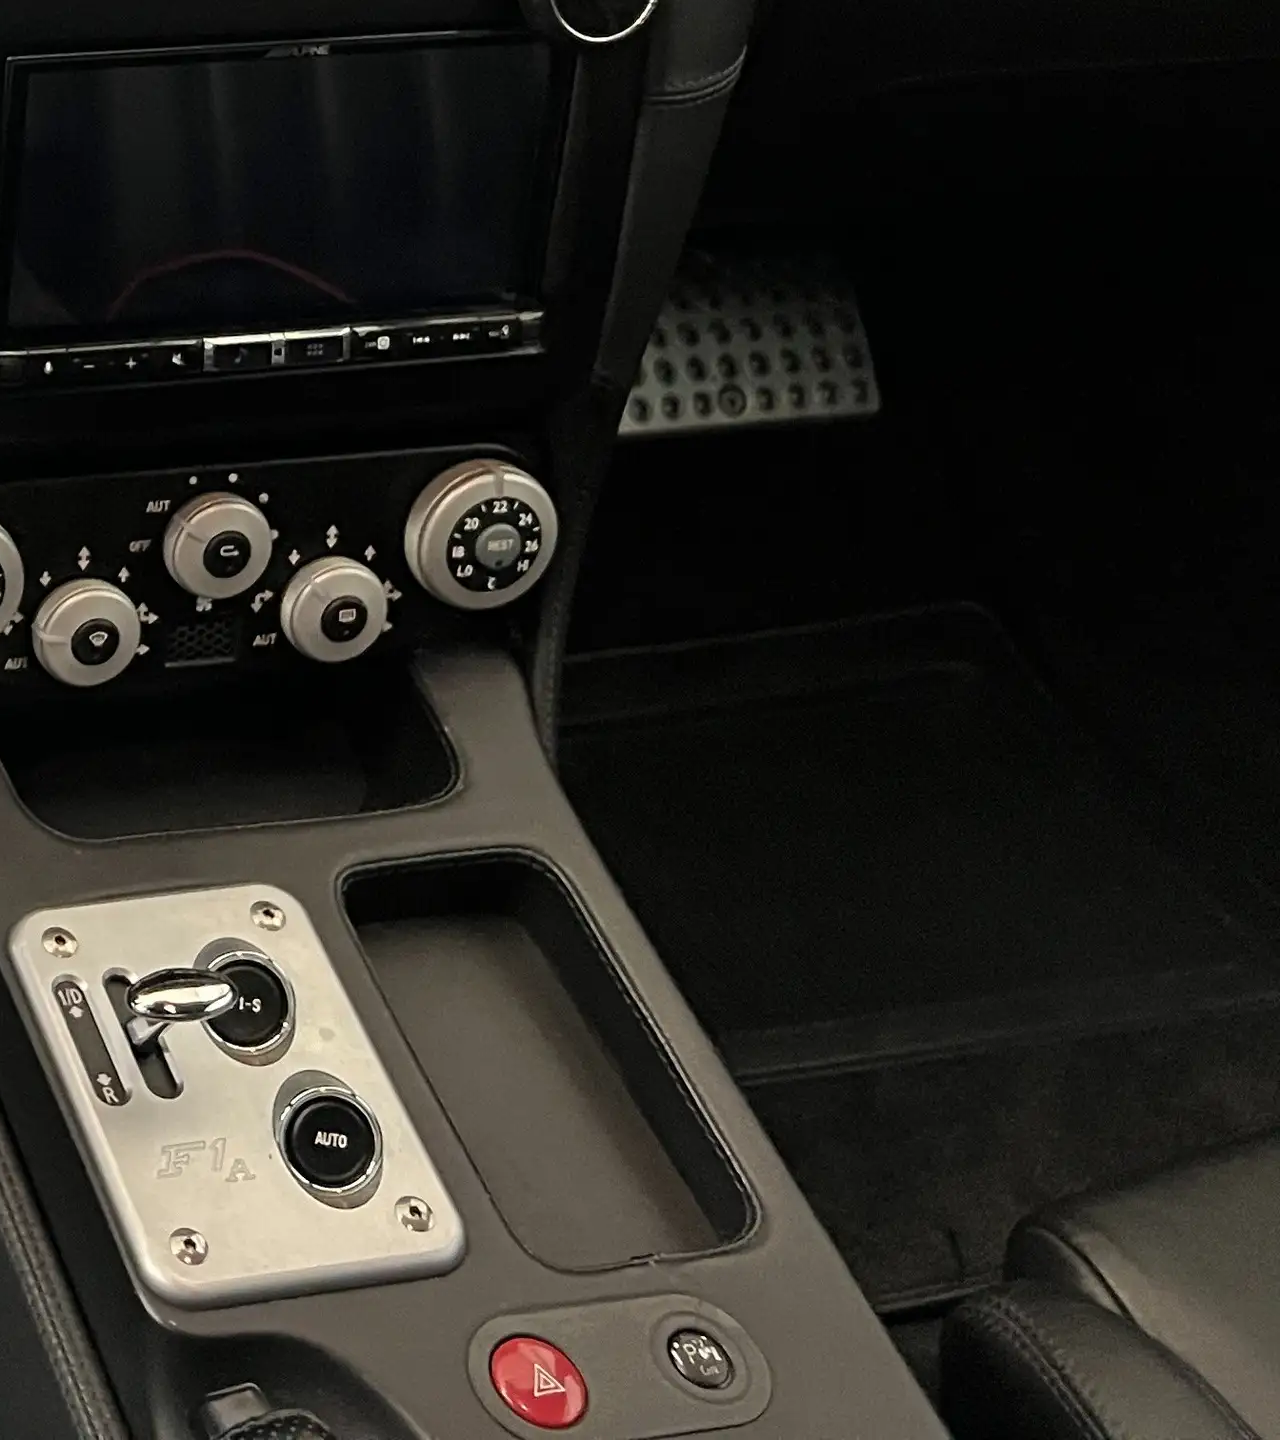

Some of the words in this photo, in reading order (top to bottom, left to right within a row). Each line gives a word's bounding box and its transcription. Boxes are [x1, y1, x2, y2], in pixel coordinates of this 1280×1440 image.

[145, 499, 172, 514] AUT
[492, 500, 508, 513] 22
[464, 517, 480, 531] 20
[518, 512, 533, 526] 24
[456, 564, 473, 578] LO
[57, 985, 83, 1007] 1/D
[104, 1086, 119, 1103] R
[313, 1129, 349, 1150] AUTO
